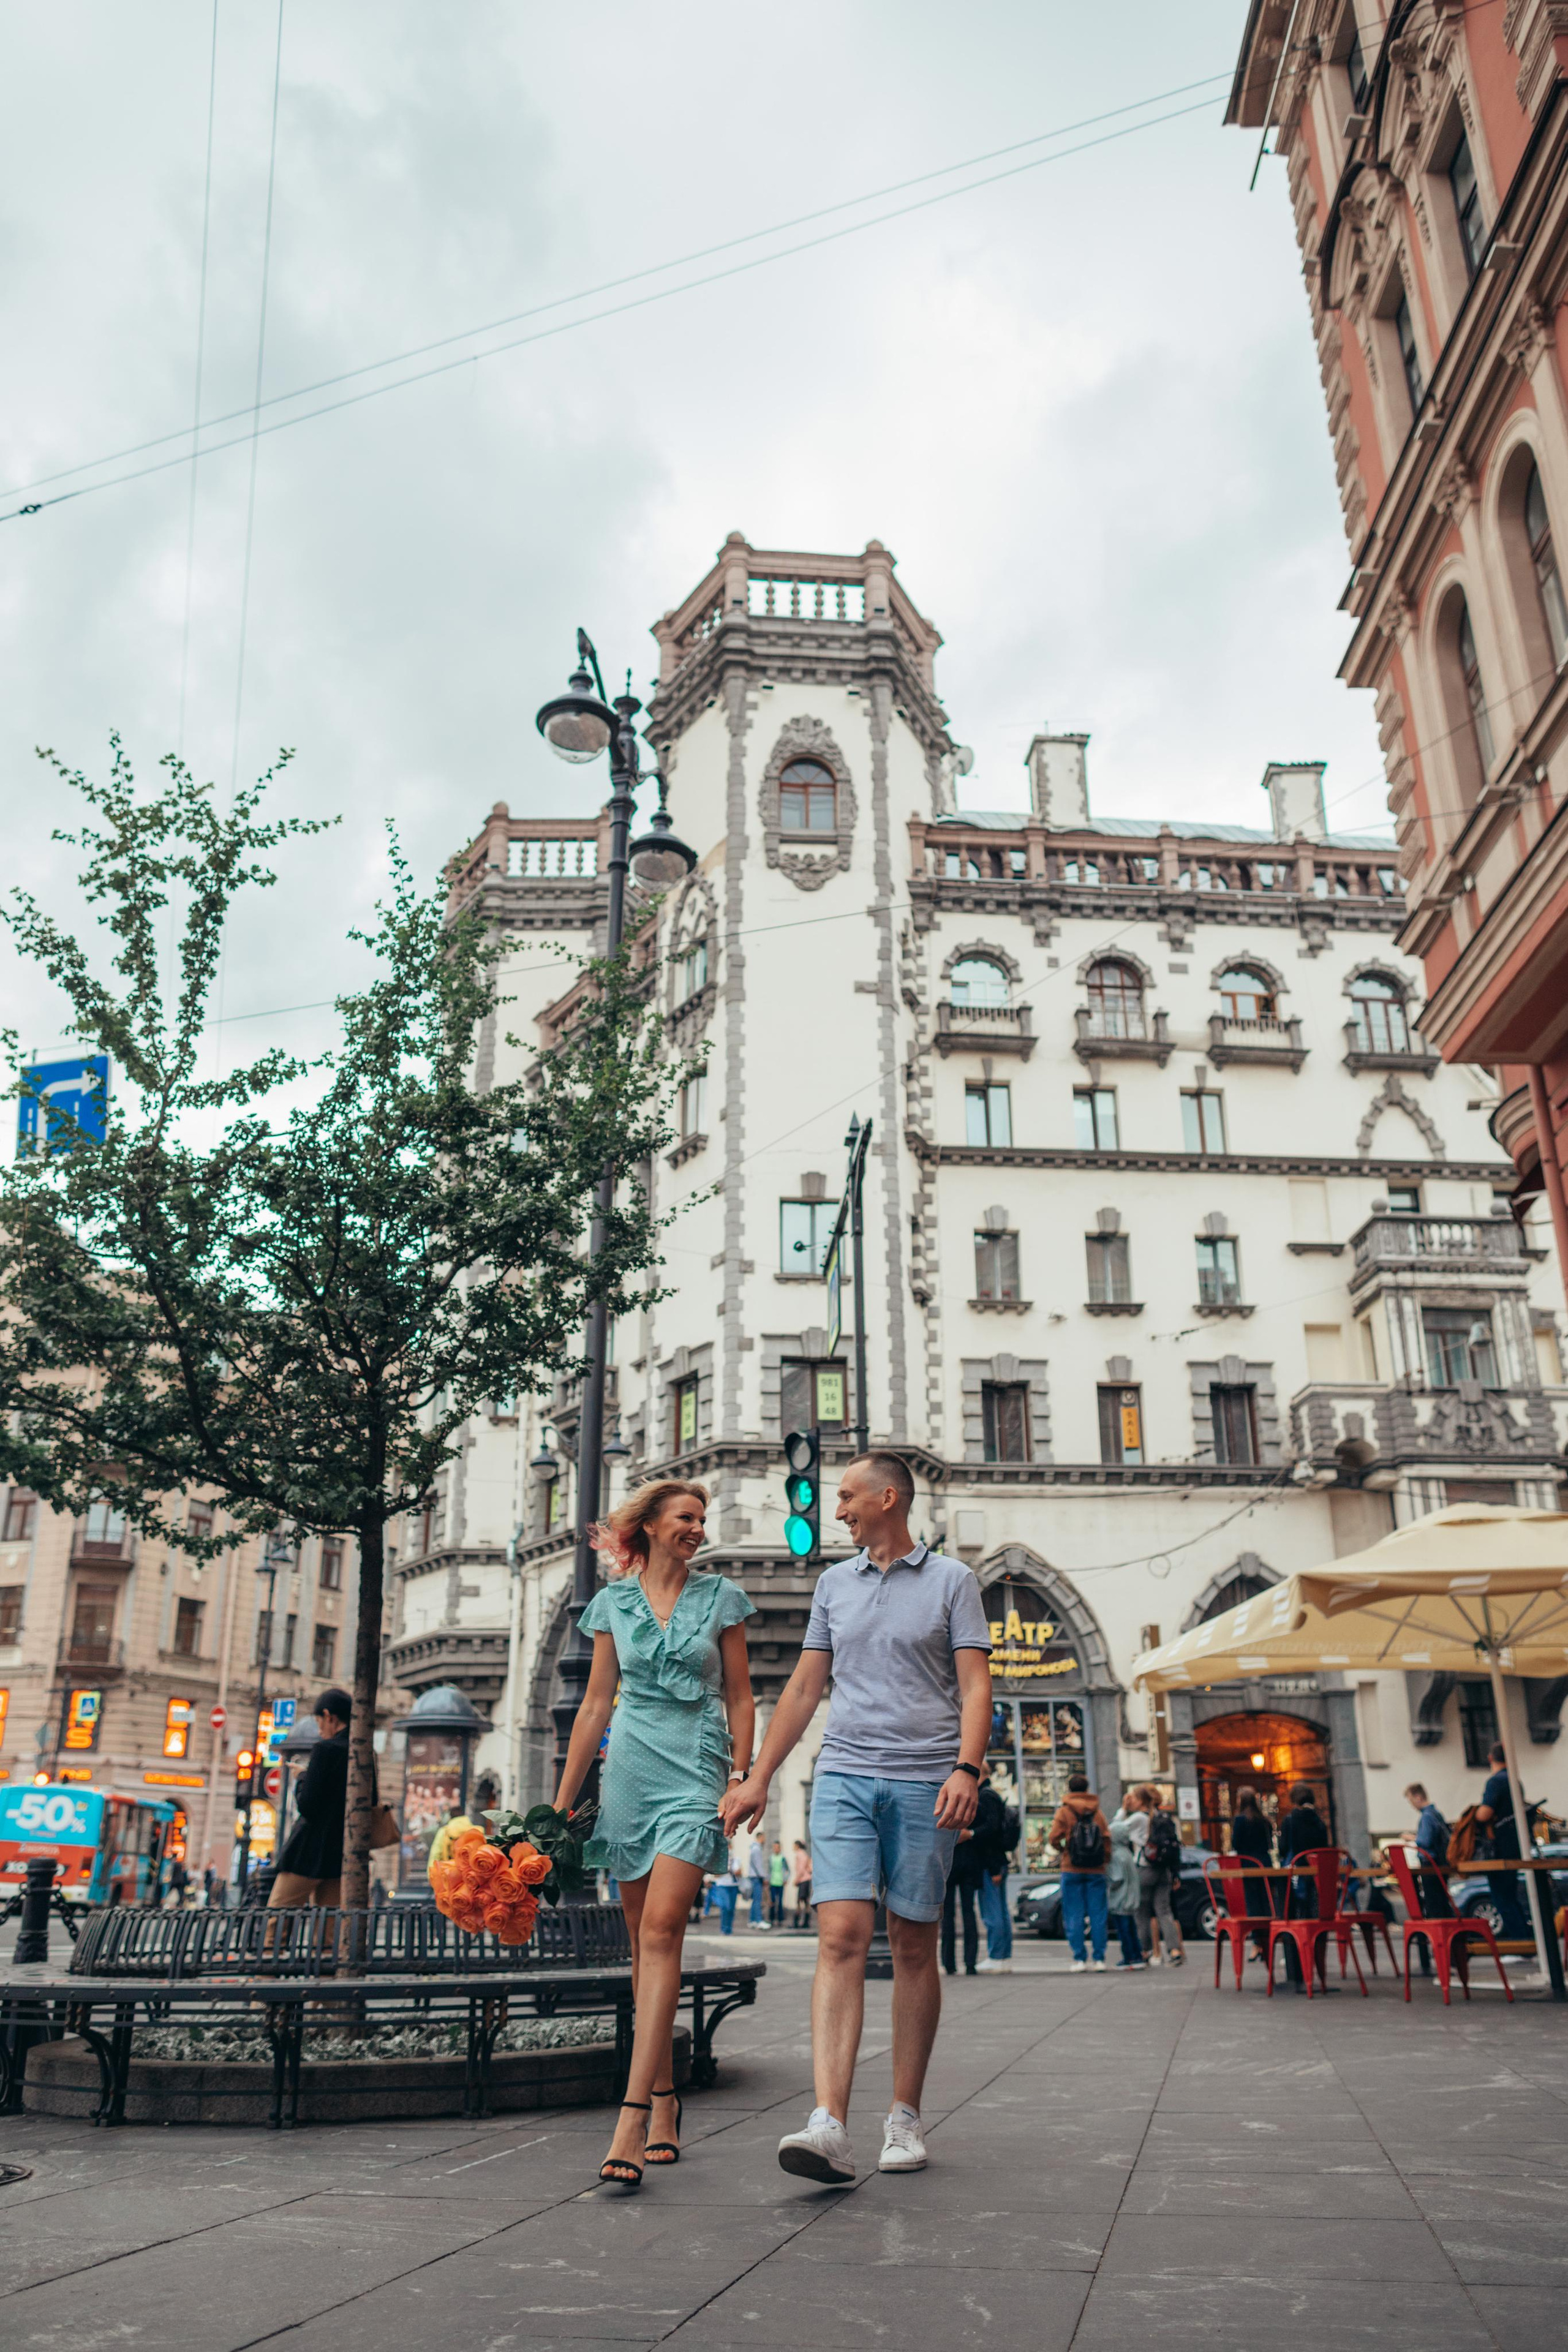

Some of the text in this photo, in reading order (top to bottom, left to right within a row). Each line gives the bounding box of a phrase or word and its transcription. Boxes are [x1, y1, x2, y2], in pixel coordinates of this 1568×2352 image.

[821, 1378, 838, 1387] 981
[825, 1392, 837, 1401] 16
[825, 1407, 837, 1415] 48
[986, 1609, 1054, 1646] ЕАТР
